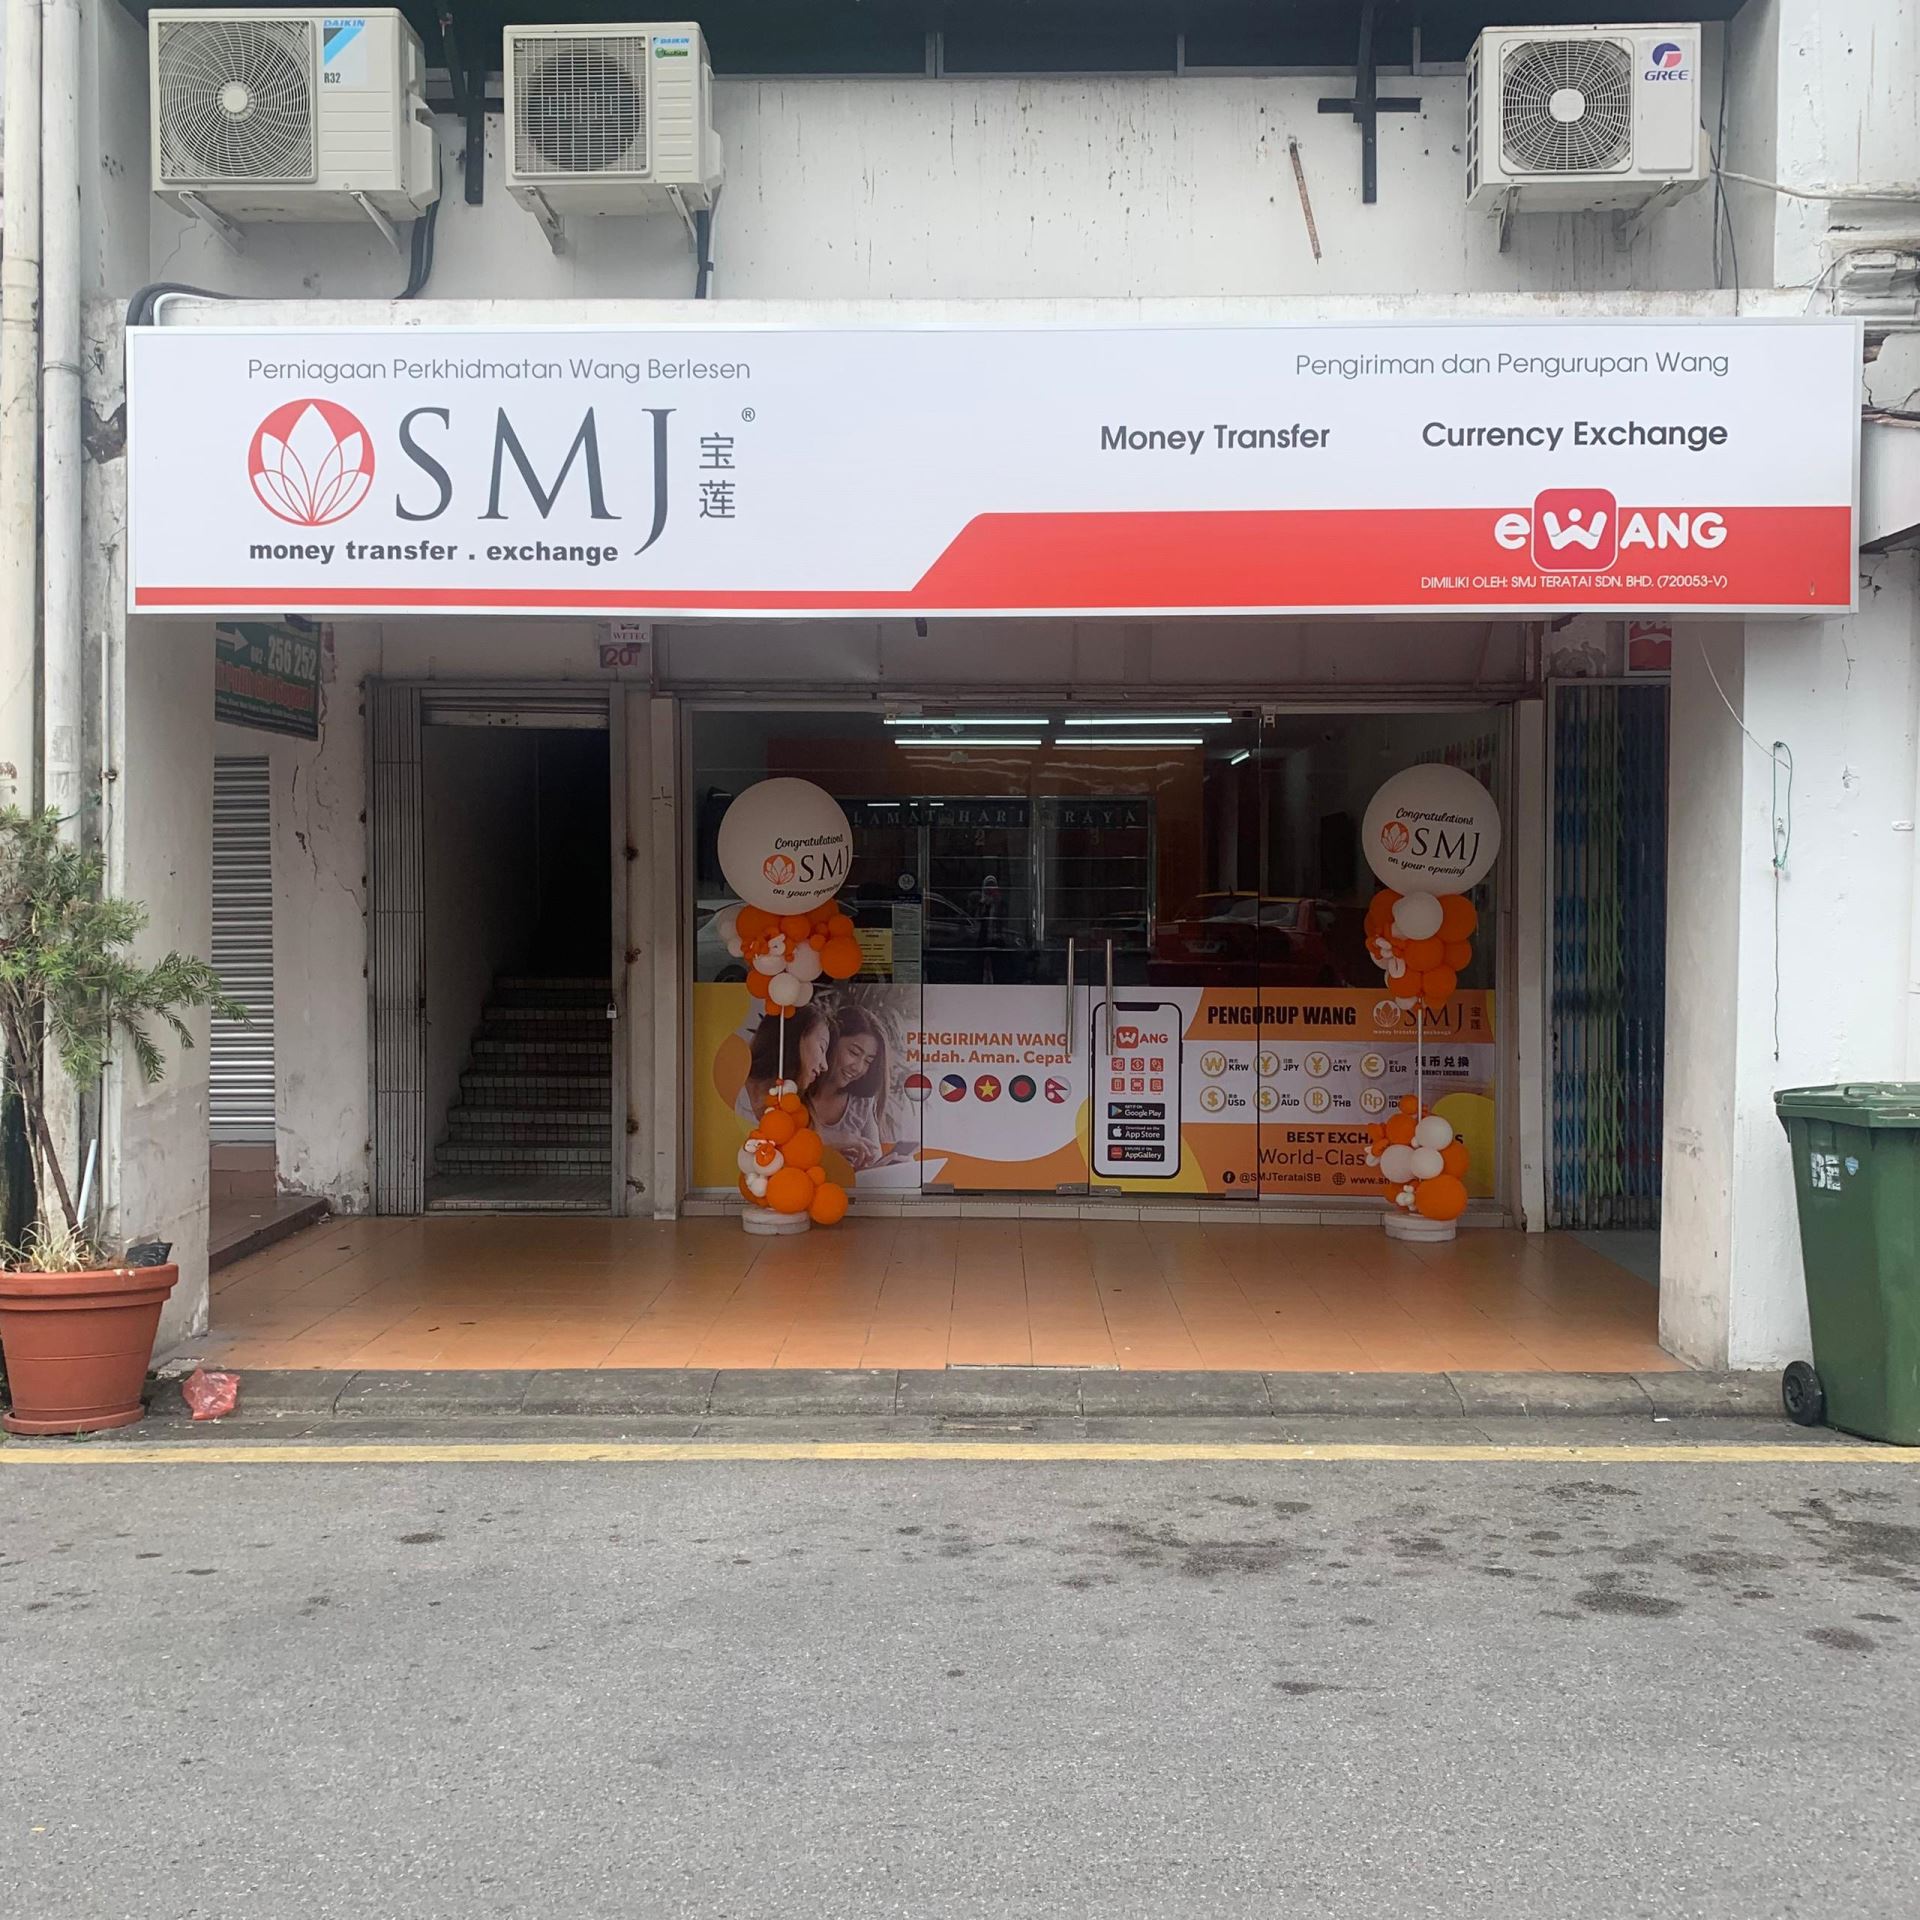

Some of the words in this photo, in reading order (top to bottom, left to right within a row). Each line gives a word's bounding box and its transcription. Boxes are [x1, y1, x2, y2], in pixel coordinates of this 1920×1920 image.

[323, 19, 366, 27] DAIKIN
[323, 72, 342, 84] R32
[1644, 70, 1690, 81] GREE
[248, 359, 387, 384] Perniagaan
[393, 358, 563, 380] Perkhidmatan
[569, 358, 641, 384] Wang
[648, 358, 751, 380] Berlesen
[1296, 354, 1435, 380] Pengiriman
[1441, 353, 1491, 375] dan
[1497, 353, 1649, 378] Pengurupan
[1655, 352, 1729, 377] Wang
[1101, 424, 1206, 455] Money
[1213, 422, 1331, 449] Transfer
[1422, 421, 1565, 452] Currency
[1573, 420, 1728, 451] Exchange
[395, 406, 677, 557] SMJ
[698, 431, 736, 520] 宝莲
[249, 543, 336, 565] money
[345, 540, 459, 560] transfer
[486, 540, 619, 567] exchange
[1421, 575, 1470, 589] DIMILIKI
[1472, 575, 1508, 588] OLEH:
[1511, 575, 1537, 588] SMJ
[1539, 575, 1592, 588] TERATAI
[1594, 575, 1623, 588] SDN.
[1625, 575, 1654, 588] BHD.
[1656, 575, 1728, 589] (720053-V)
[1395, 807, 1474, 826] Congratulations
[774, 833, 844, 852] Congratulations
[1411, 828, 1481, 870] SMJ
[1387, 856, 1399, 865] on
[1400, 860, 1426, 871] your
[1427, 864, 1466, 878] opening
[772, 888, 785, 896] on
[787, 889, 812, 899] your
[1208, 1006, 1298, 1025] PENGURUP
[1303, 1007, 1356, 1025] WANG
[906, 1032, 1013, 1046] PENGIRIMAN
[1016, 1034, 1067, 1046] WANG
[906, 1050, 965, 1063] Mudah.
[968, 1051, 1020, 1064] Aman.
[1023, 1052, 1072, 1067] Cepat
[1283, 1064, 1299, 1072] JPY
[1332, 1064, 1352, 1072] CNY
[1389, 1065, 1407, 1073] EUR
[1332, 1100, 1352, 1108] THB
[1125, 1110, 1147, 1118] Google
[1148, 1110, 1161, 1118] Play
[1125, 1131, 1140, 1139] App
[1287, 1132, 1325, 1143] BEST
[1125, 1151, 1161, 1160] AppGallery
[1259, 1149, 1367, 1167] World-Clas
